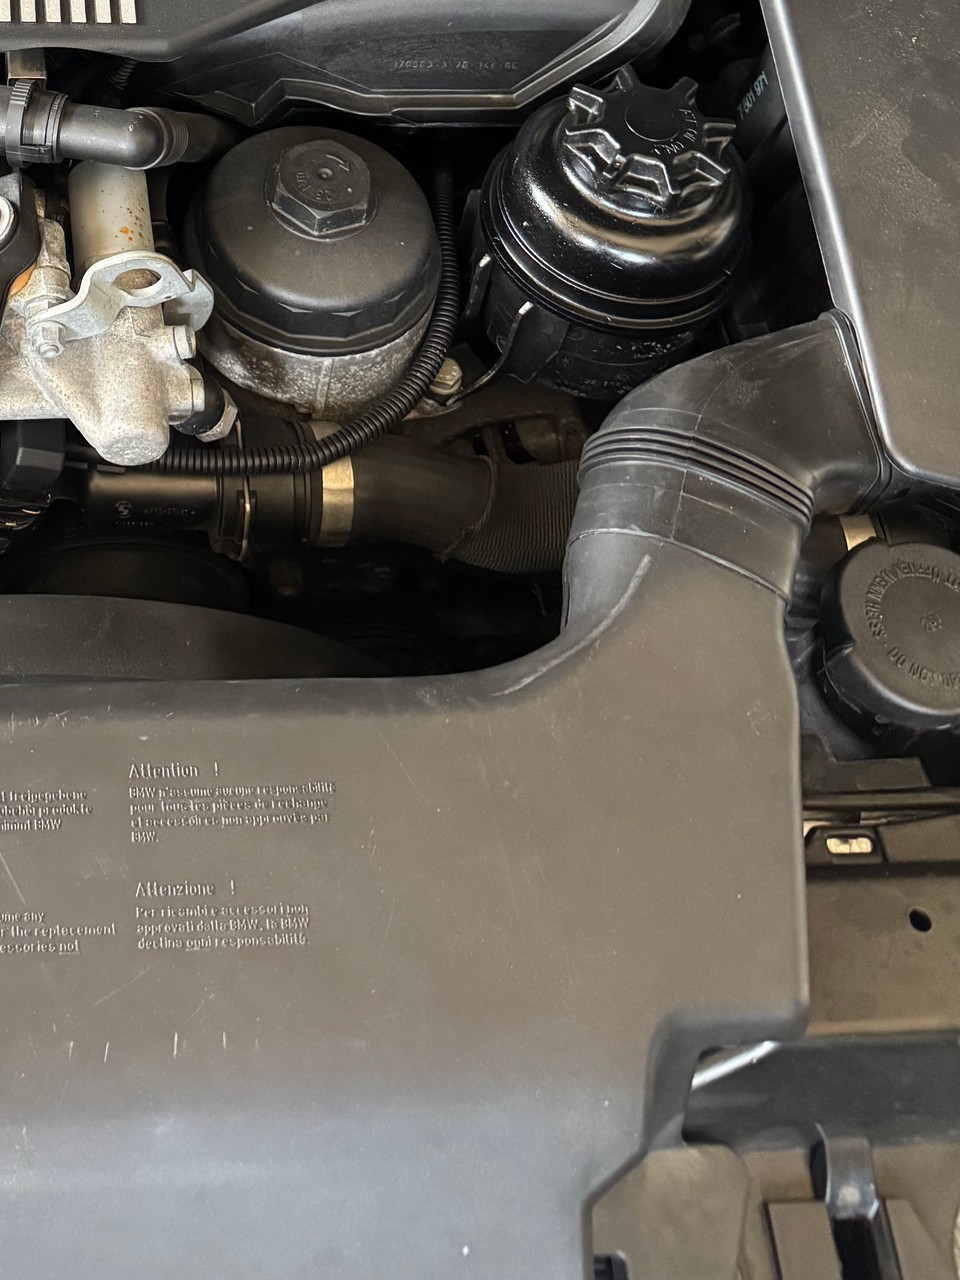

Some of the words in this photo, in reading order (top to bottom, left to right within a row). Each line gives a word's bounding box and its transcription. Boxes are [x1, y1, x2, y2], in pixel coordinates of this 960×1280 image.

[743, 88, 756, 114] 601
[296, 172, 313, 192] Nm
[316, 189, 333, 201] 25
[129, 762, 199, 779] Attention
[34, 818, 62, 831] BMW
[135, 880, 215, 898] Attenzione
[24, 912, 44, 923] any
[135, 906, 155, 918] Per
[160, 904, 209, 918] ricambi
[286, 904, 310, 916] non
[11, 925, 31, 937] the
[34, 923, 116, 939] replacement
[136, 919, 195, 936] approvati
[196, 919, 228, 932] dalla
[265, 917, 279, 931] la
[280, 917, 309, 930] BMW
[59, 939, 80, 953] not
[137, 936, 183, 950] declina
[185, 935, 212, 951] ogni
